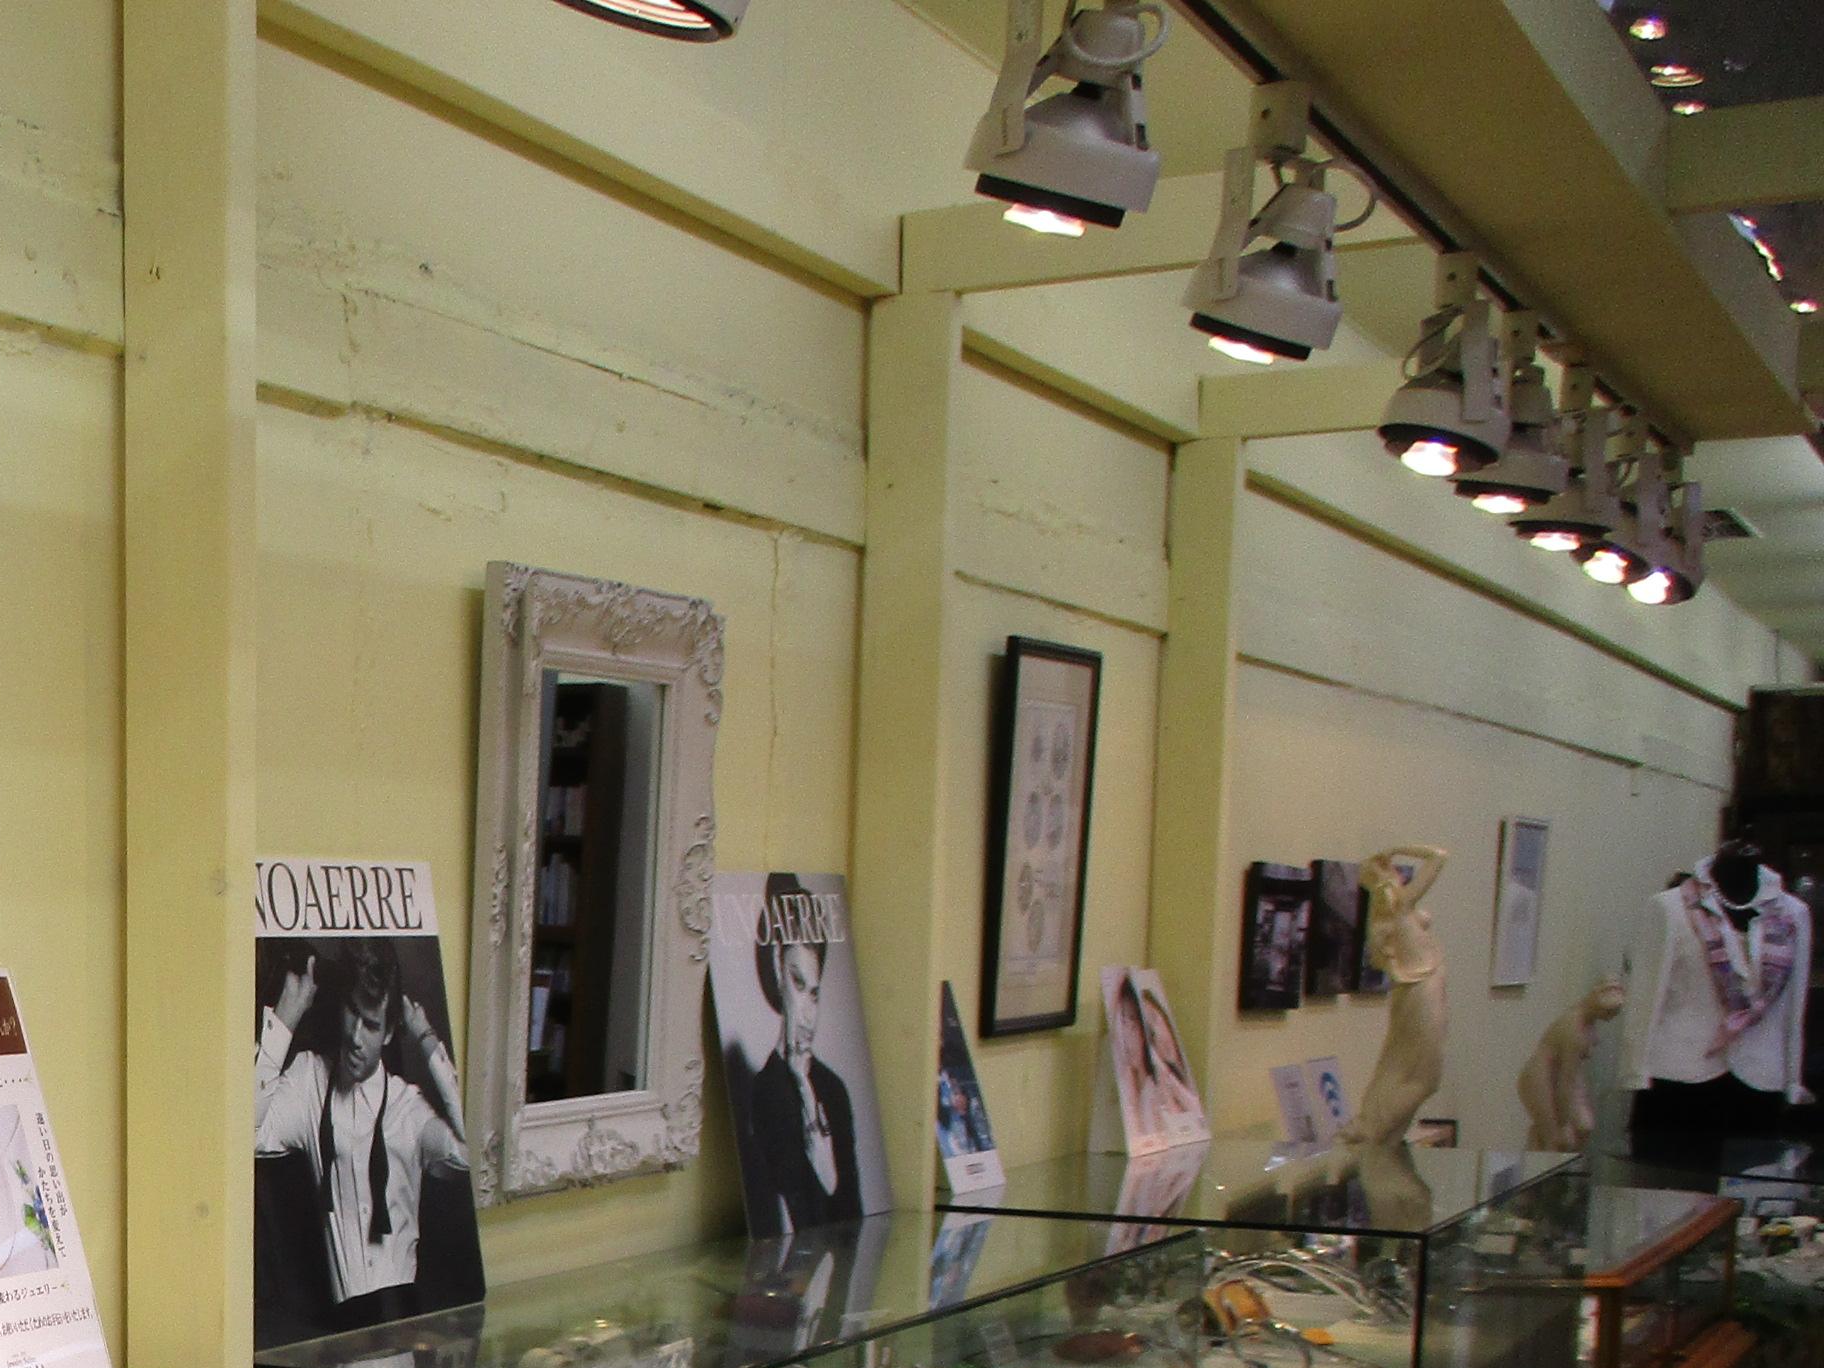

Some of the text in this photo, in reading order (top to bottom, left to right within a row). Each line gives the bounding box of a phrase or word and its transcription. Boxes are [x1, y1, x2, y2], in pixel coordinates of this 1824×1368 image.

[35, 1112, 68, 1217] 遠い日の思い出が
[38, 1166, 67, 1258] かたちを変えて
